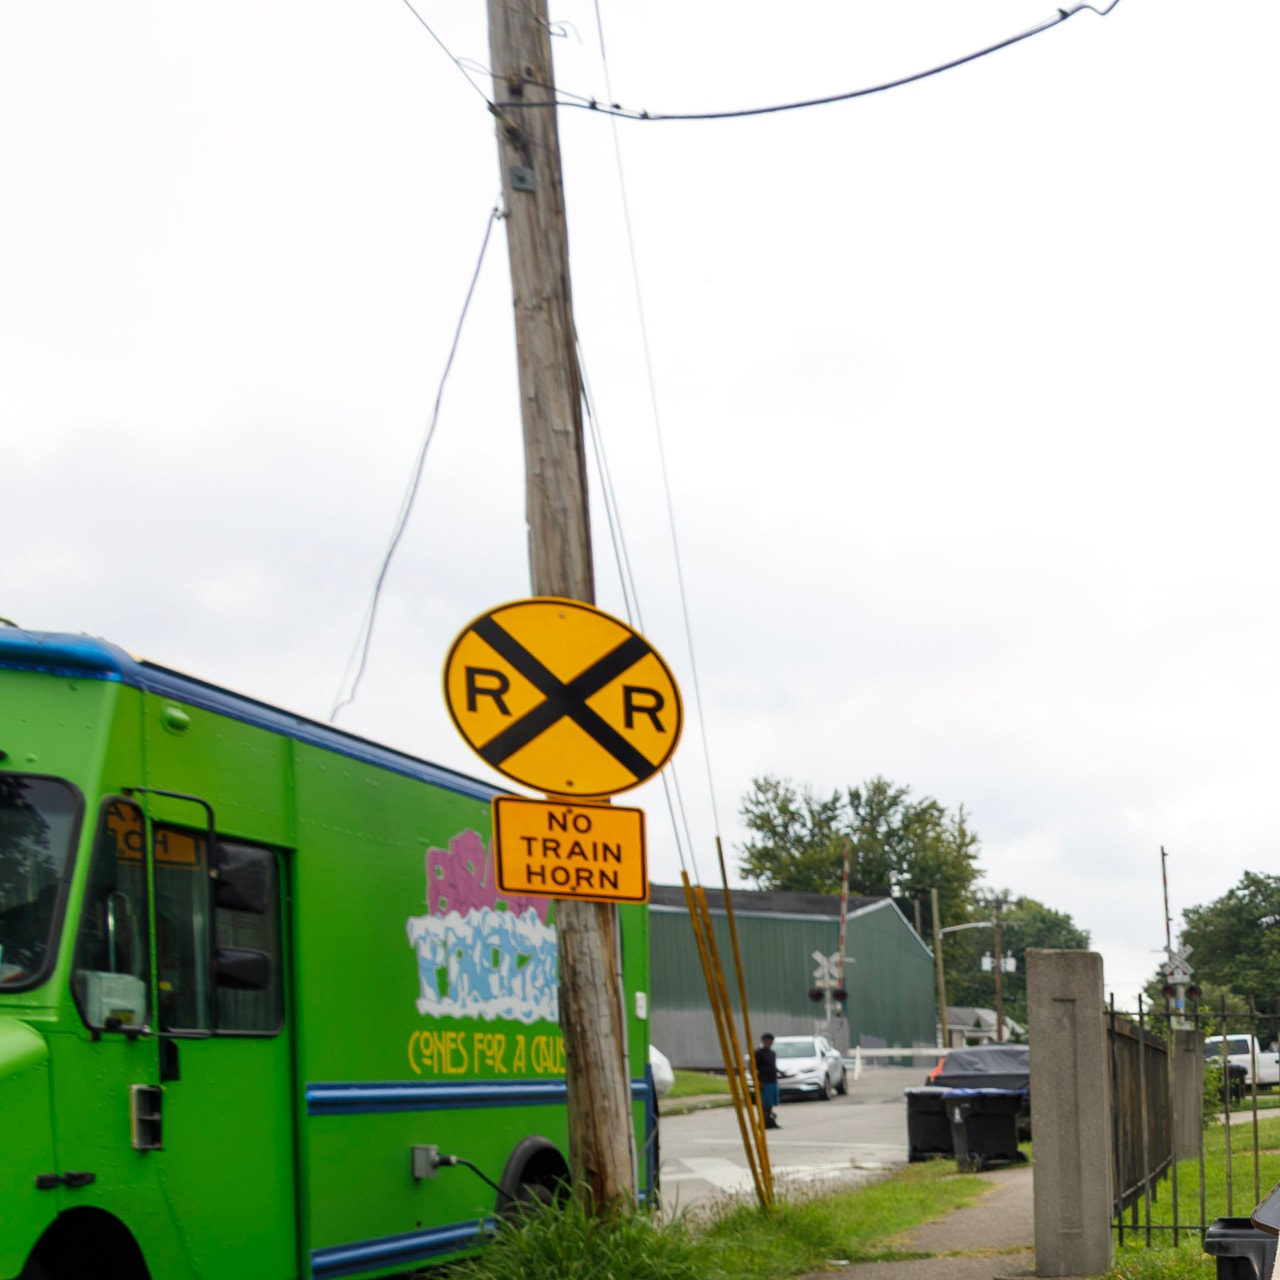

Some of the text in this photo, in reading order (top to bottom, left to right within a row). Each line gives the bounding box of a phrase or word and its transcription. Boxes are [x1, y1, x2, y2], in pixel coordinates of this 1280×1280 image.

[465, 666, 666, 733] R R
[546, 809, 593, 835] NO
[520, 835, 624, 865] TRAIN
[526, 862, 621, 891] HORN
[408, 1030, 566, 1074] CONES FOR A CAUS
